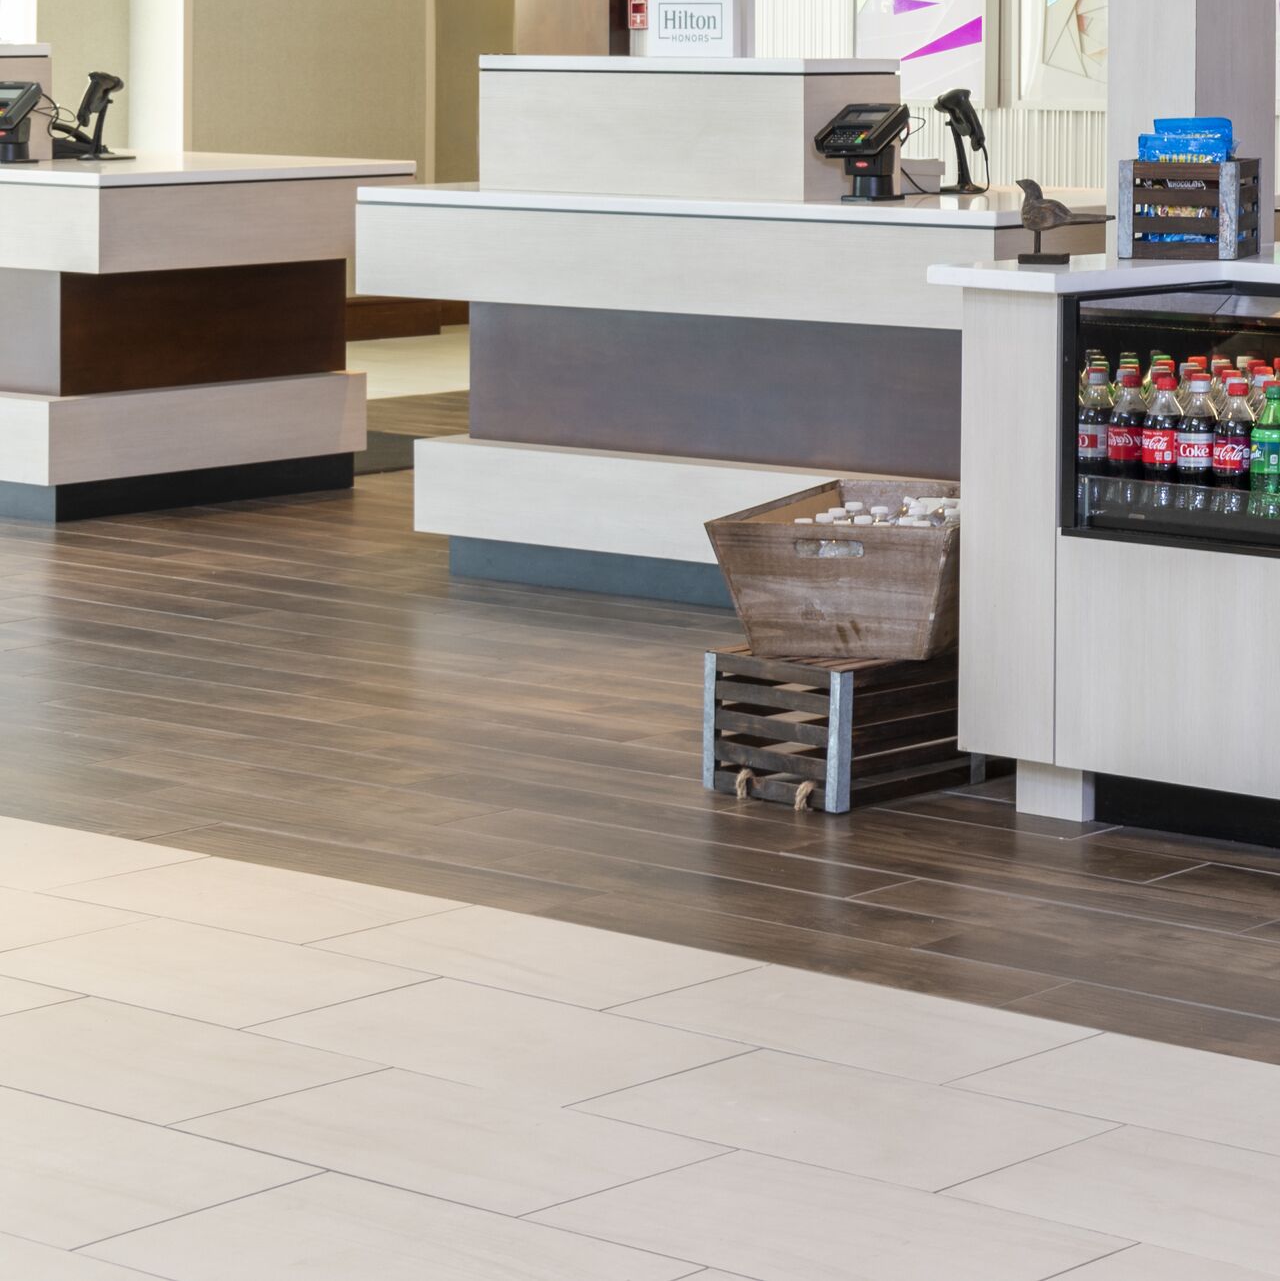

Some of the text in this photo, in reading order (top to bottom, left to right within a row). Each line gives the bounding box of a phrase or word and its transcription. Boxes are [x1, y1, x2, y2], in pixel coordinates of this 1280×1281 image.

[664, 10, 717, 30] Hilton
[671, 34, 710, 43] HONORS
[1180, 443, 1209, 457] Coke
